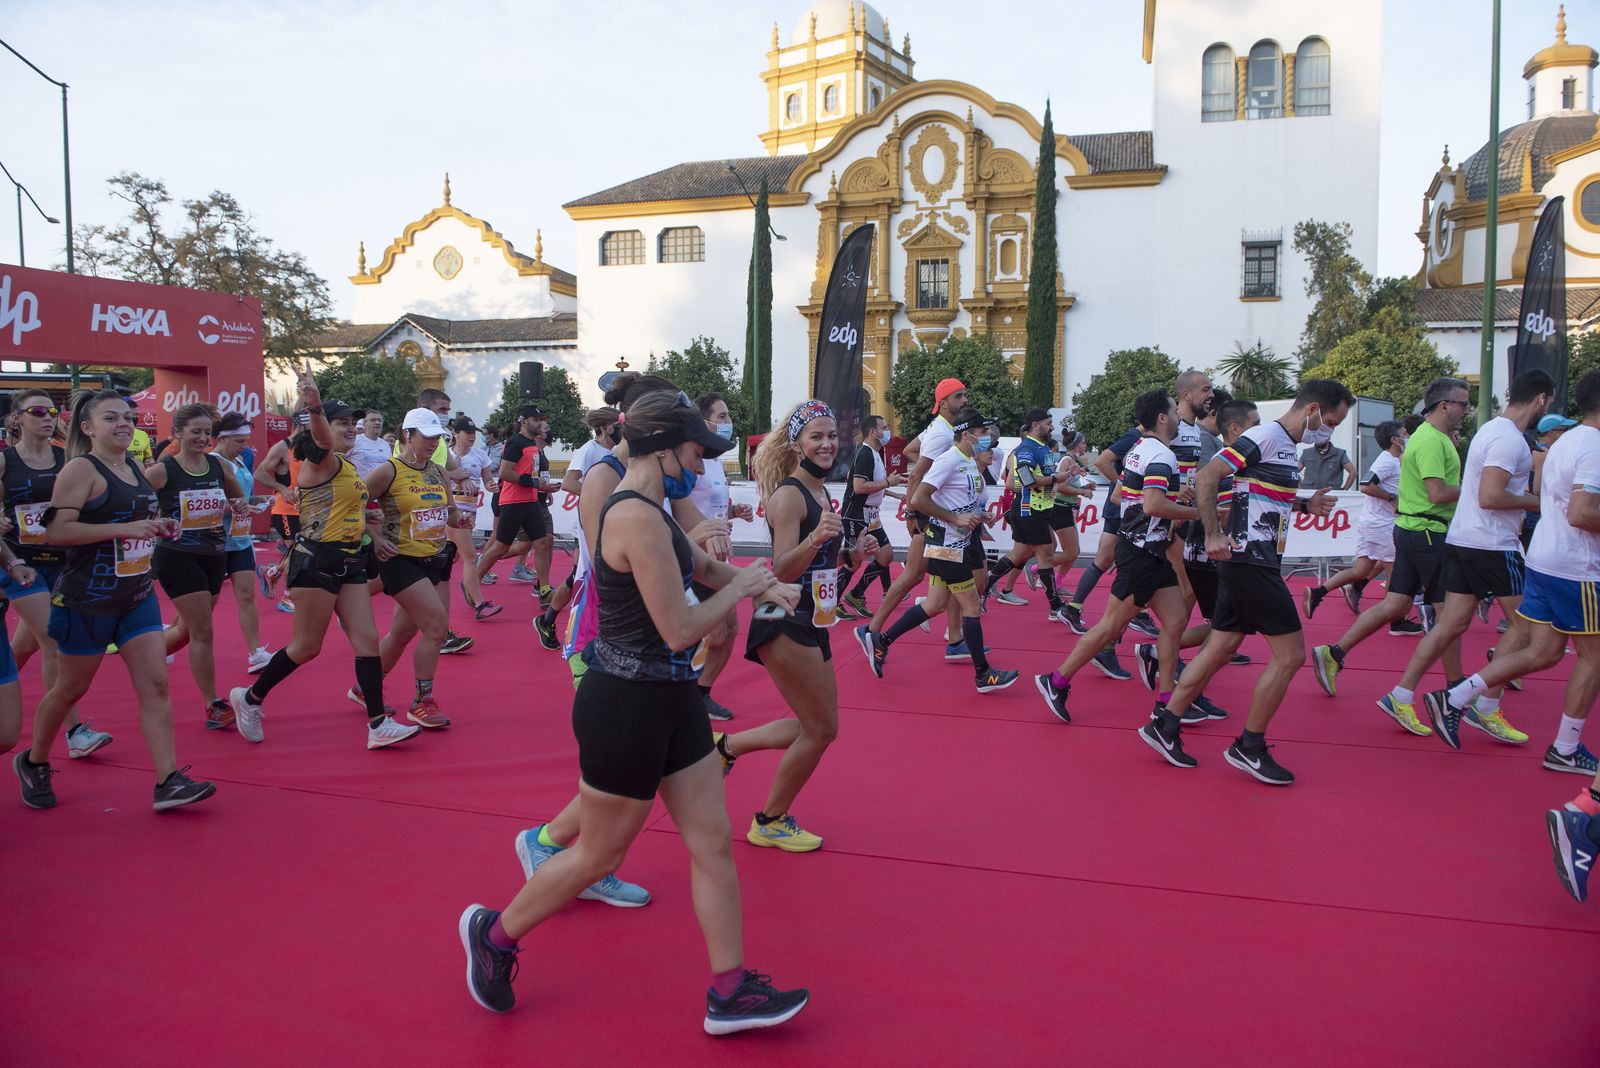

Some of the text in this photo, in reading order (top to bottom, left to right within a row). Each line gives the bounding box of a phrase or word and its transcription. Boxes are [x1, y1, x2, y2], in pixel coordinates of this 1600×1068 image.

[91, 303, 171, 337] HOKA
[1525, 309, 1556, 341] edp
[829, 322, 857, 351] edp
[217, 384, 261, 421] edp
[187, 499, 219, 511] 6288
[416, 509, 442, 521] 6542
